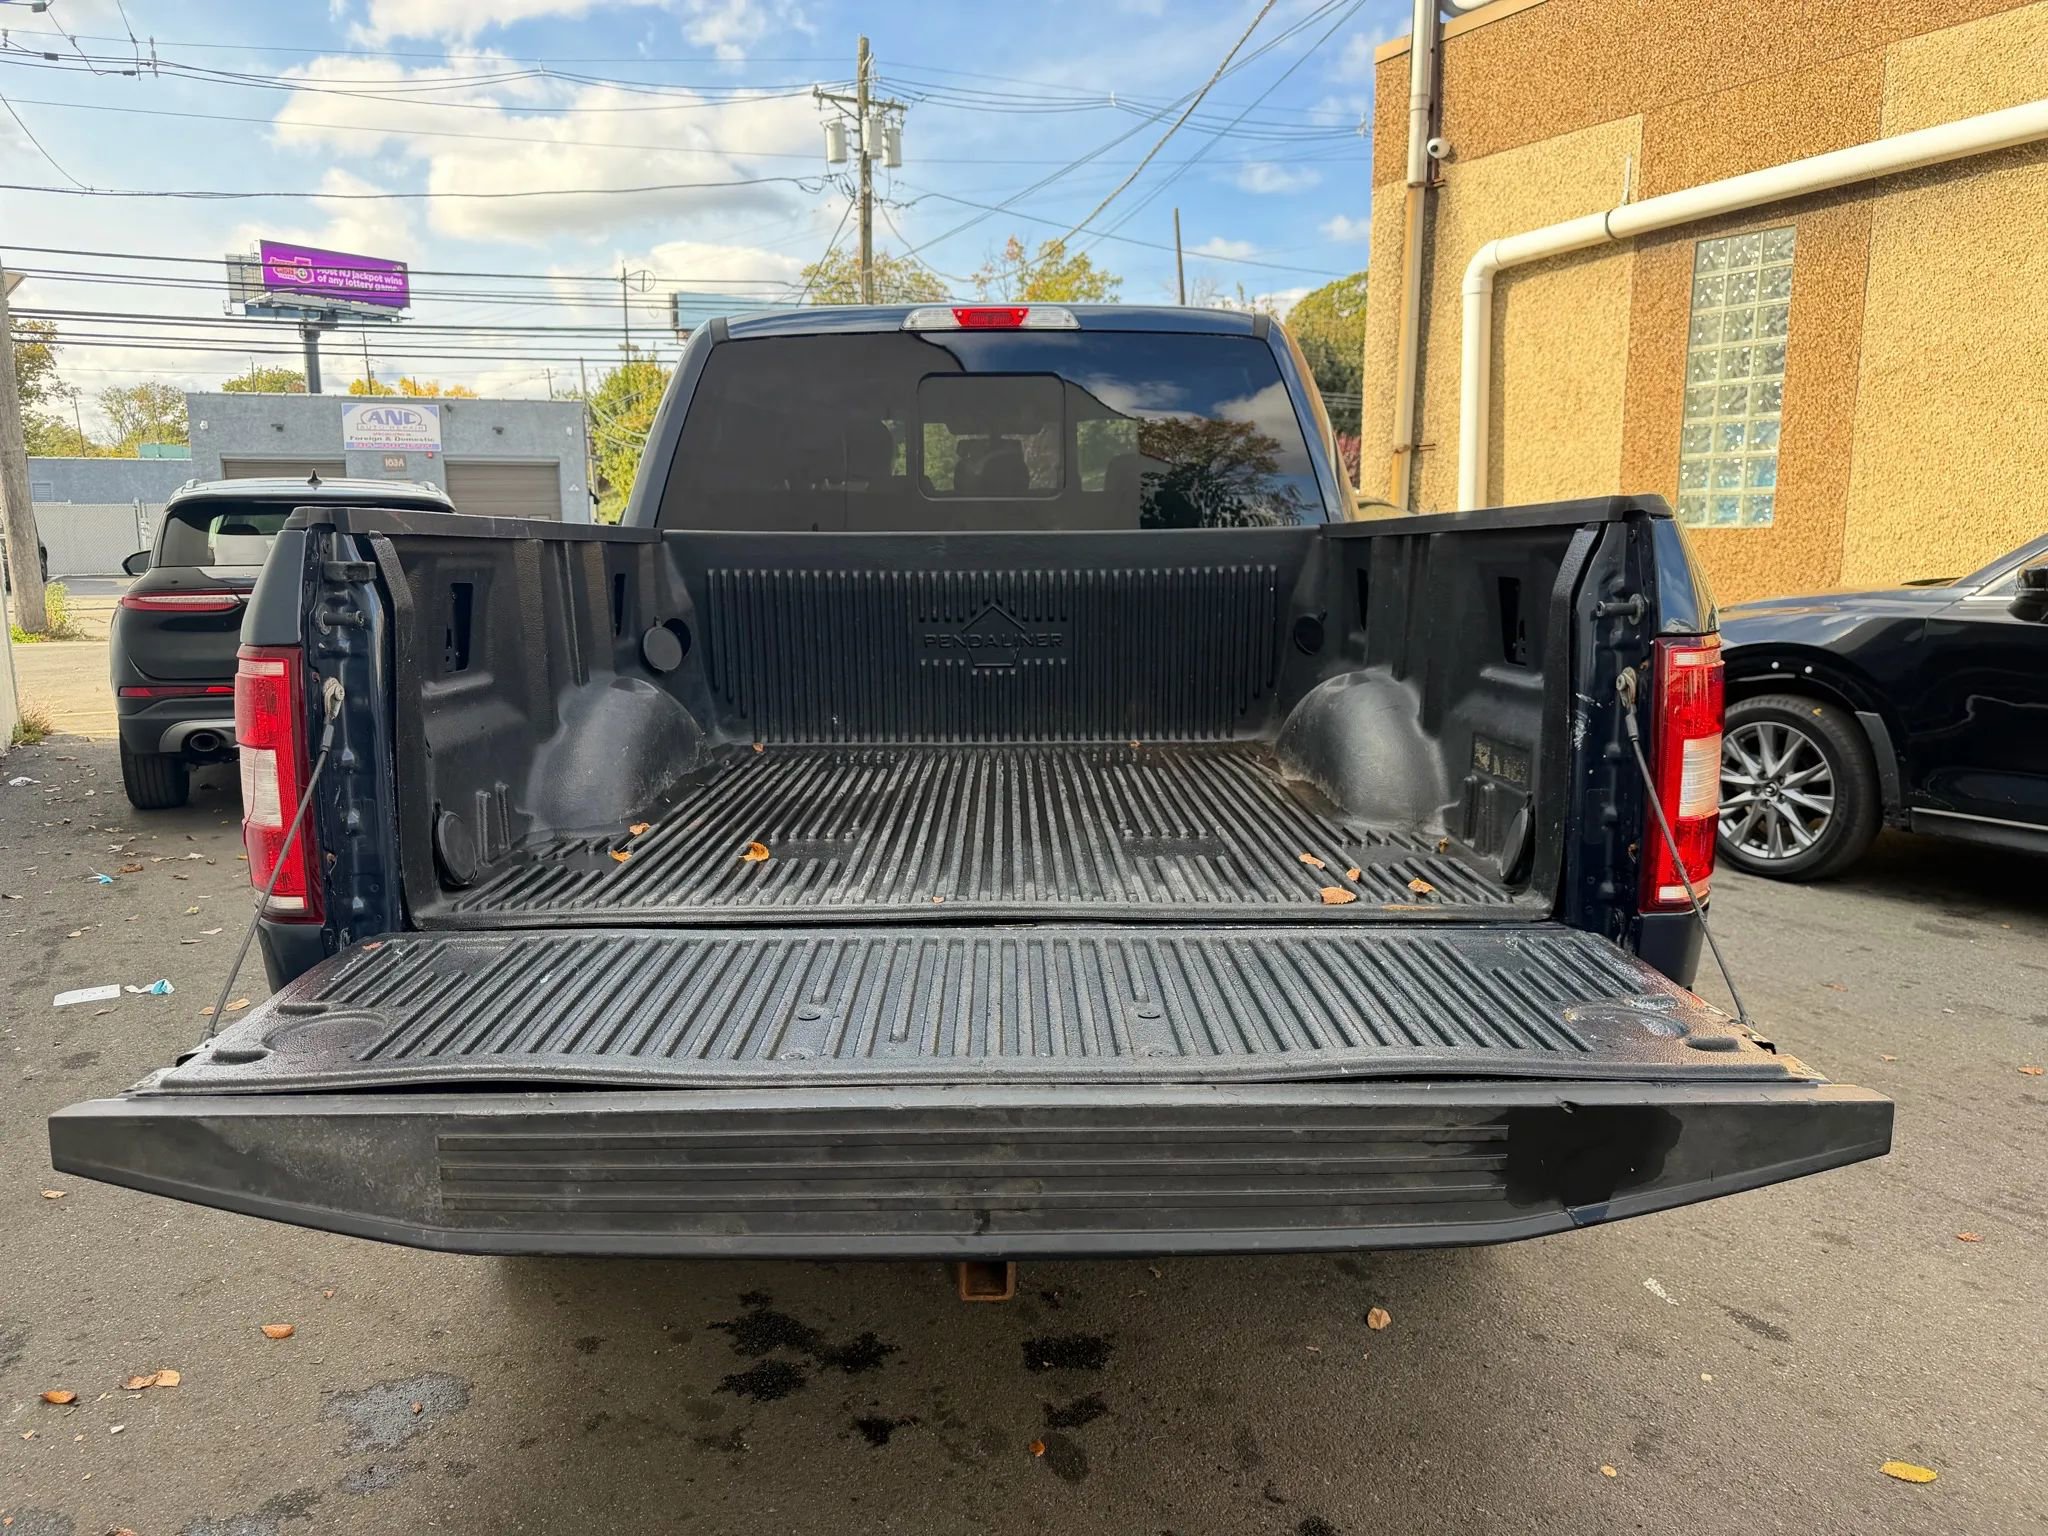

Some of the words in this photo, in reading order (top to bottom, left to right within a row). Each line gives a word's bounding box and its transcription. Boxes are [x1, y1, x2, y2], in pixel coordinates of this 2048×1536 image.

[317, 274, 327, 282] of
[328, 276, 344, 287] any
[345, 278, 374, 291] lottery
[339, 270, 351, 278] NJ
[352, 271, 383, 283] jackpot
[384, 276, 403, 285] wins
[384, 457, 405, 467] 103A
[924, 633, 1064, 649] PENDALINER
